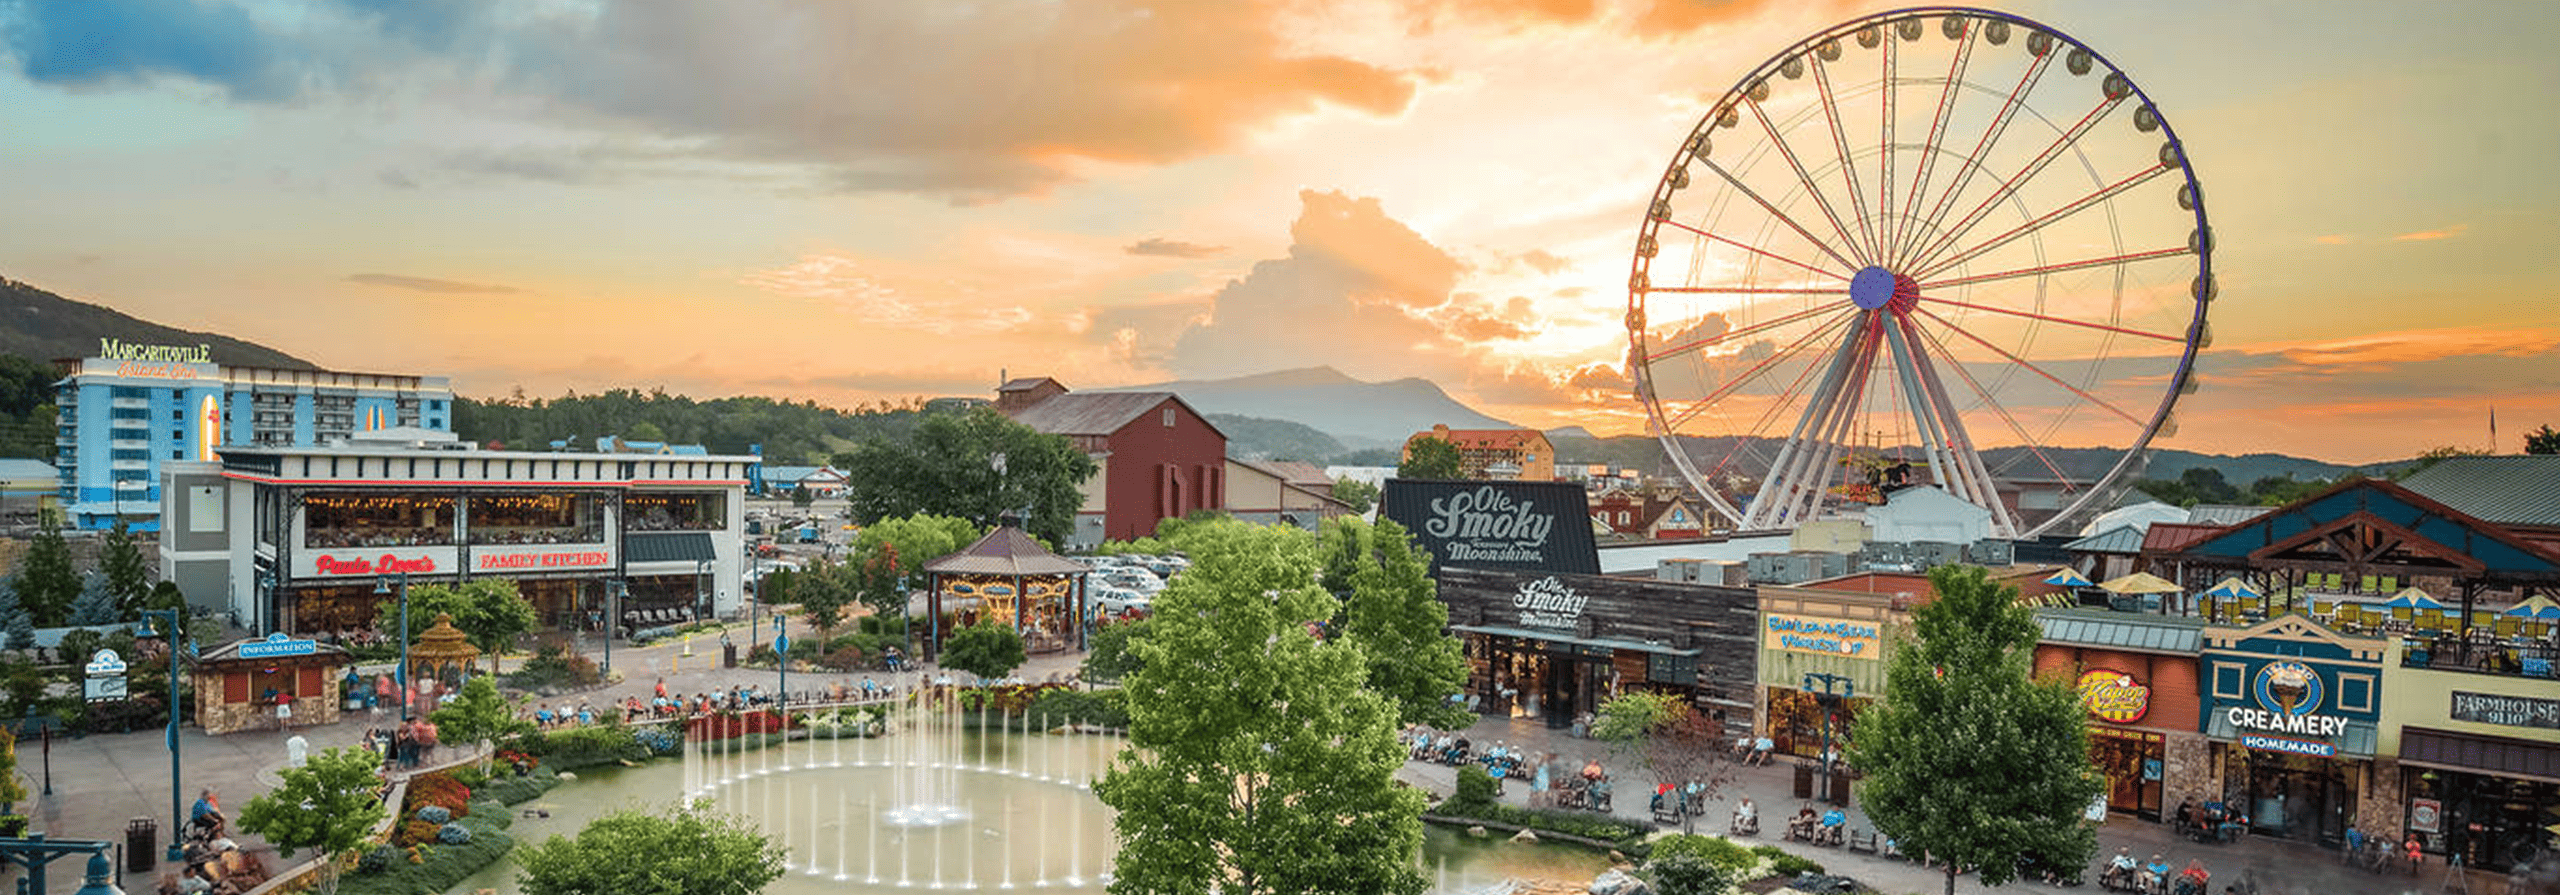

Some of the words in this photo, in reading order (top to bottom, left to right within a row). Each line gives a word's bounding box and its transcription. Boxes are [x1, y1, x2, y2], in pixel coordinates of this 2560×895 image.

[101, 337, 211, 363] MARGARITAVILLE
[1474, 485, 1518, 514] Ole
[1426, 491, 1554, 547] Smoky
[316, 555, 372, 575] Paula
[374, 553, 436, 574] Deen's
[480, 553, 538, 569] FAMILY
[541, 551, 608, 567] KITCHEN
[1542, 575, 1567, 595] Ole
[1512, 580, 1588, 618] Smoky
[242, 643, 313, 654] INFORMATION
[2455, 694, 2559, 723] FARMHOUSE
[2488, 711, 2524, 725] 9110
[2228, 706, 2348, 736] CREAMERY
[2245, 736, 2329, 756] HOMEMADE
